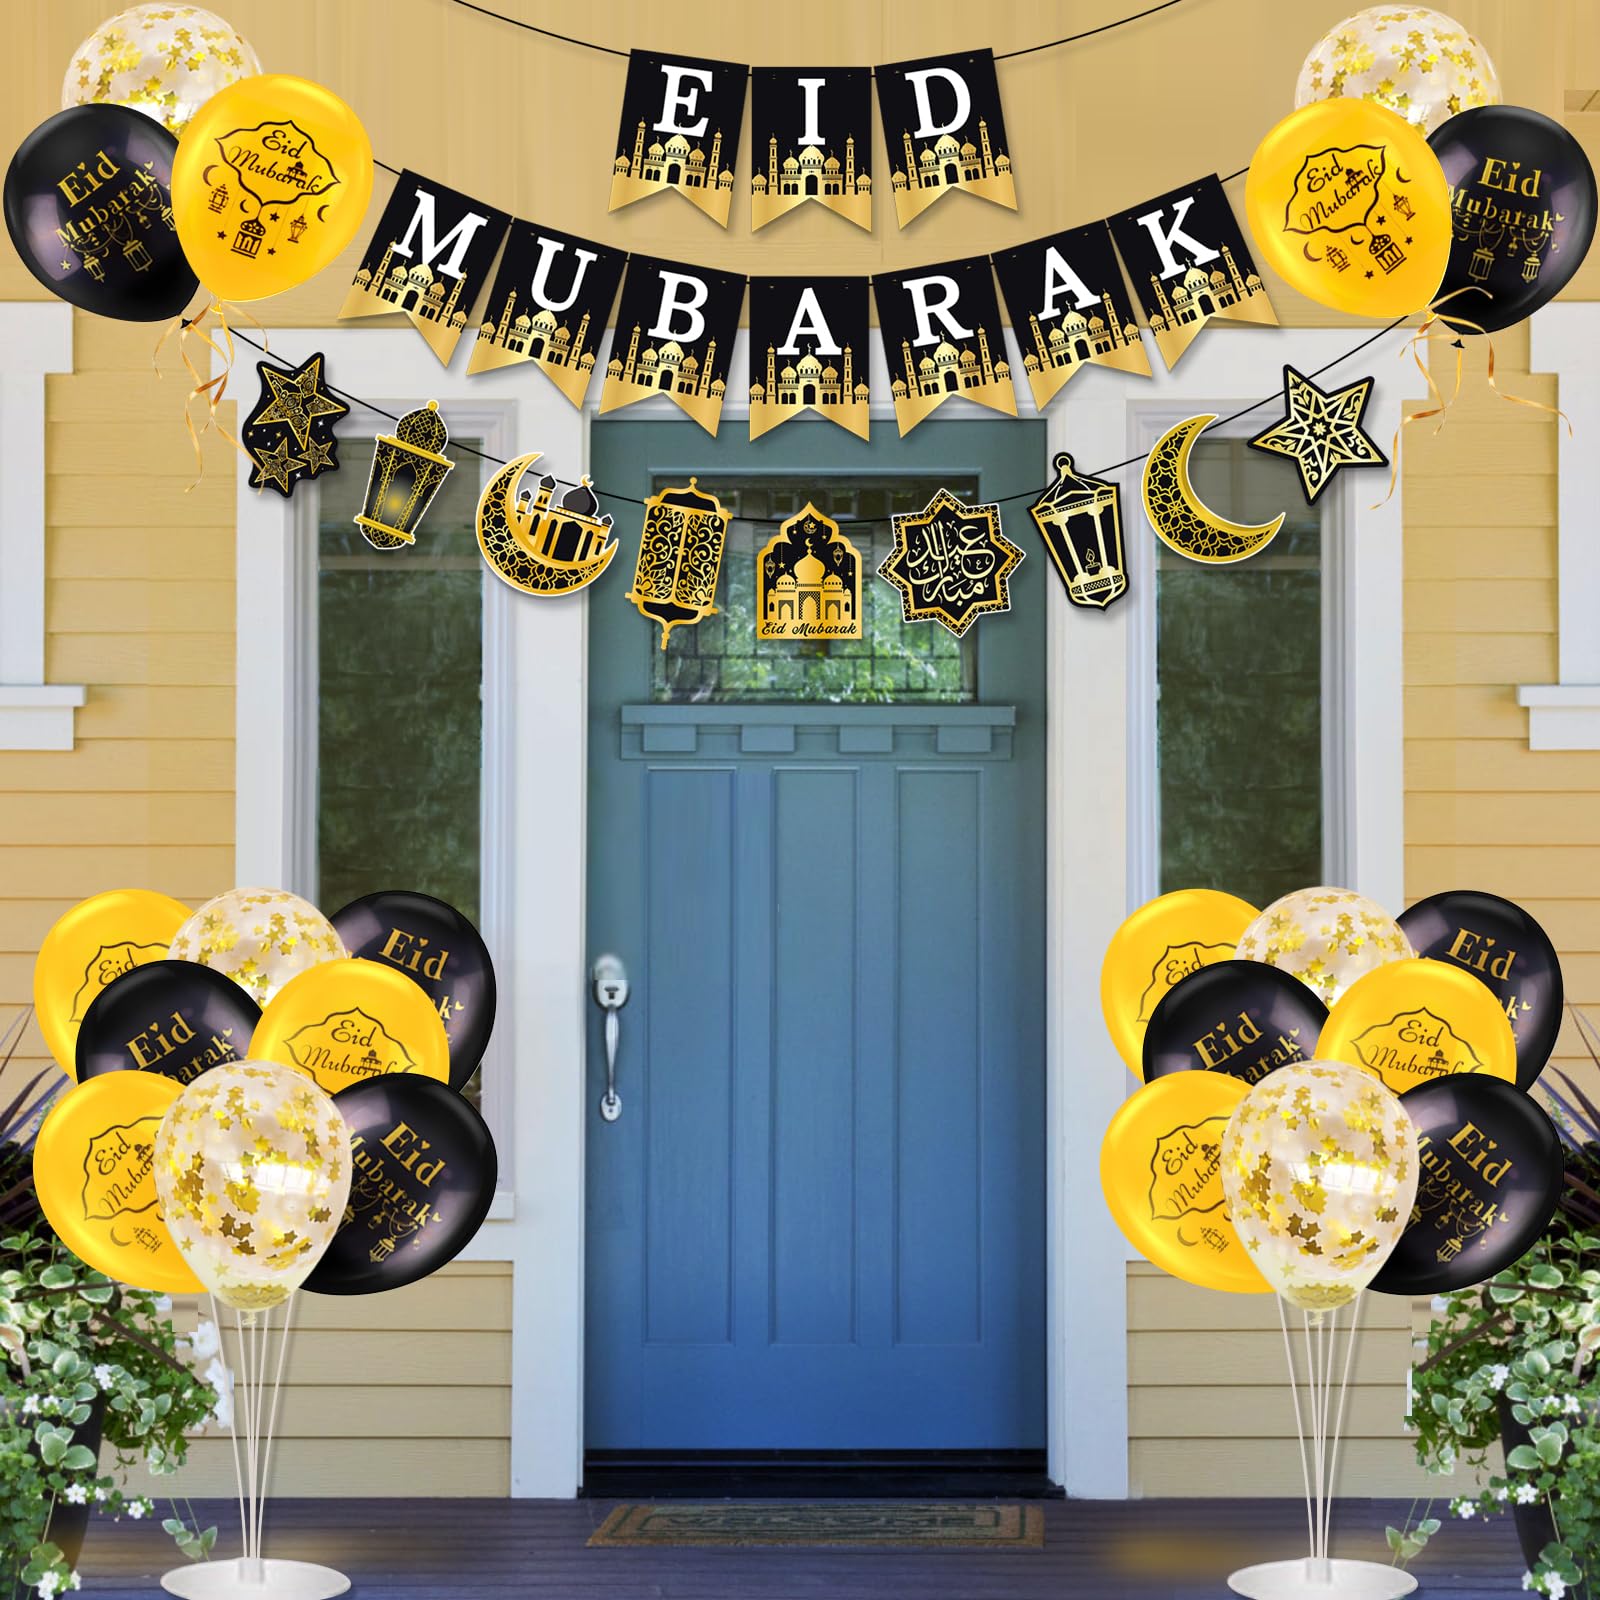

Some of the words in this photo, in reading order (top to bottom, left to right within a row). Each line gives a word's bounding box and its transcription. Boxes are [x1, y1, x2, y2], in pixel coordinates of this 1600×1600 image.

[652, 64, 971, 145] EID
[262, 130, 308, 160] Eid
[56, 151, 120, 208] Eid
[229, 147, 320, 195] Mubarak
[1300, 159, 1383, 230] Mubarak
[1306, 154, 1344, 193] Eid
[1477, 157, 1541, 198] Eid
[55, 169, 156, 247] Mubarak
[1448, 184, 1553, 231] Mubarak
[392, 189, 1220, 355] MUBARAK
[762, 621, 787, 635] Eid
[792, 622, 857, 637] Mubarak
[99, 948, 137, 985] Eid
[378, 928, 449, 981] Eid
[1166, 948, 1204, 985] Eid
[1445, 928, 1516, 981] Eid
[125, 1011, 196, 1070] Eid
[331, 1020, 377, 1047] Eid
[1192, 1011, 1264, 1070] Eid
[1398, 1020, 1444, 1047] Eid
[160, 1035, 234, 1083] arak
[1226, 1035, 1301, 1083] arak
[95, 1131, 131, 1175] Eid
[380, 1121, 446, 1187] Eid
[1162, 1131, 1198, 1175] Eid
[1446, 1121, 1512, 1187] Eid
[98, 1160, 154, 1213] Muba
[1166, 1160, 1220, 1213] Muba
